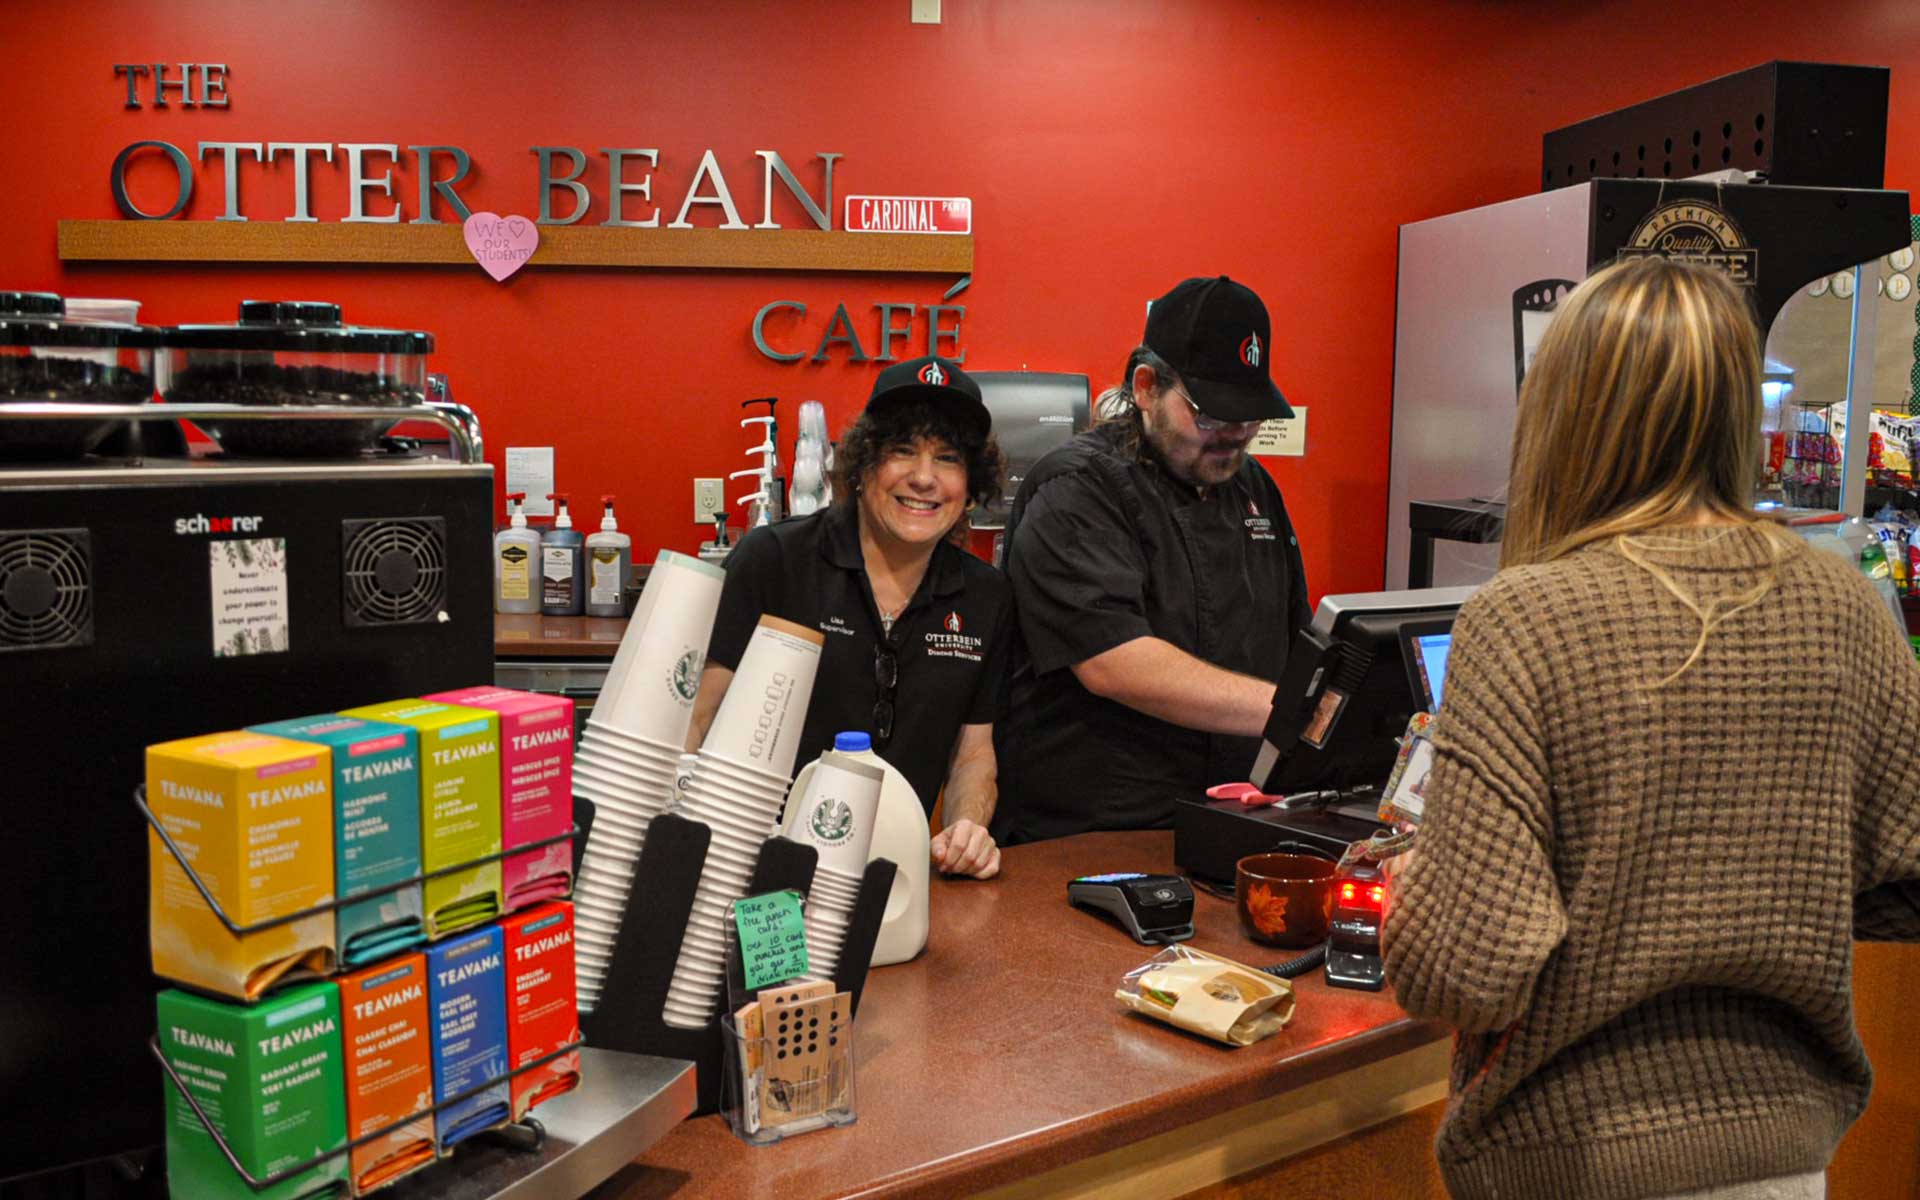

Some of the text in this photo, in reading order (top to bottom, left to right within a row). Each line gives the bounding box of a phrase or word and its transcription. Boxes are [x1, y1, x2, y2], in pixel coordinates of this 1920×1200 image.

[113, 63, 229, 108] THE
[110, 140, 843, 231] OTTER BEAN
[474, 220, 505, 238] WE
[861, 199, 938, 231] CARDINAL
[1650, 207, 1726, 234] PREMIUM
[484, 239, 511, 250] OUR
[1661, 233, 1716, 257] Quality
[752, 275, 972, 364] CAFÉ
[175, 514, 263, 534] schaerer
[925, 633, 981, 647] OTTERBEIN
[432, 741, 496, 766] TEAVANA
[512, 727, 570, 751] TEAVANA
[342, 757, 414, 784] TEAVANA
[160, 779, 225, 809] TEAVANA
[247, 780, 326, 809] TEAVANA
[740, 903, 762, 914] Take
[515, 930, 571, 961] TEAVANA
[438, 954, 500, 987] TEAVANA
[353, 984, 422, 1019] TEAVANA
[171, 1026, 235, 1057] TEAVANA
[258, 1017, 335, 1056] TEAVANA
